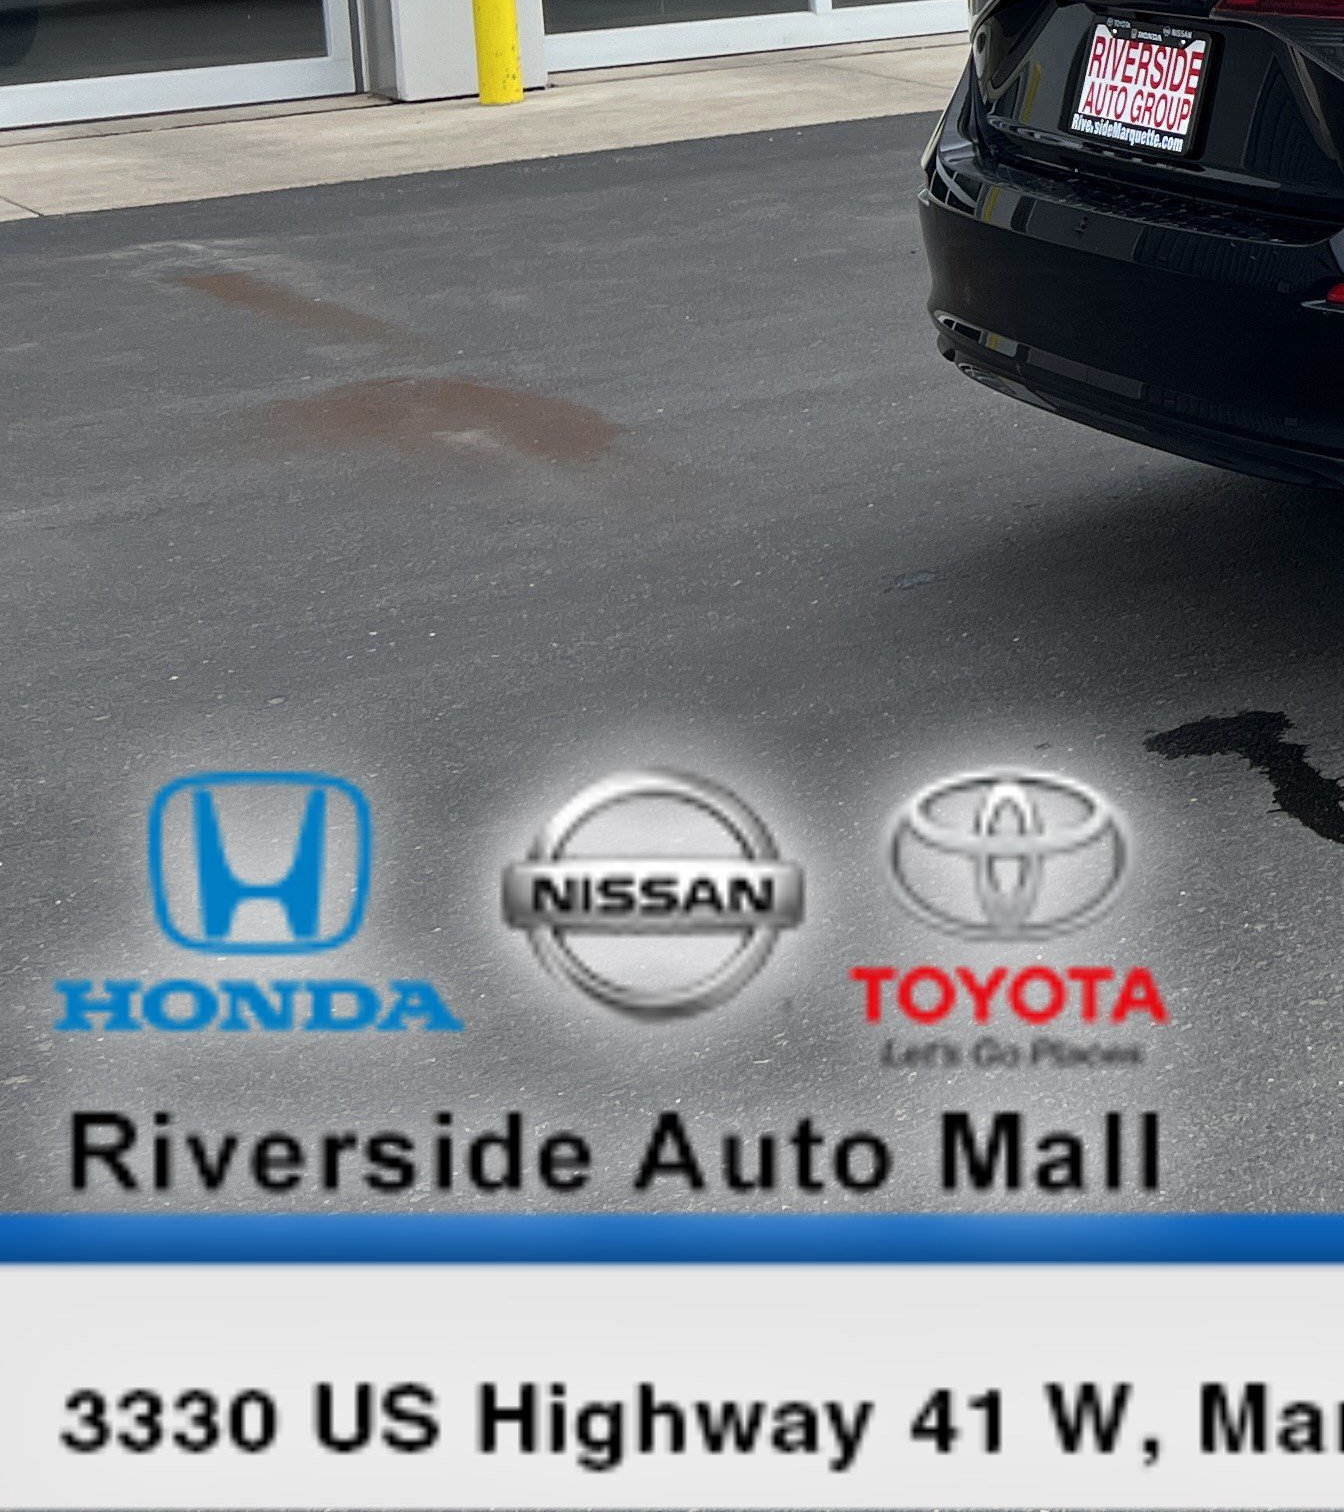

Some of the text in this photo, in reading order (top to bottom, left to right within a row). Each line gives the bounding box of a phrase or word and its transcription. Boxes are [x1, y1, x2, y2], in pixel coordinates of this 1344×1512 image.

[1171, 28, 1193, 39] NISSAN
[1088, 35, 1205, 95] RIVERSIDE
[1082, 81, 1192, 131] AUTO GROUP
